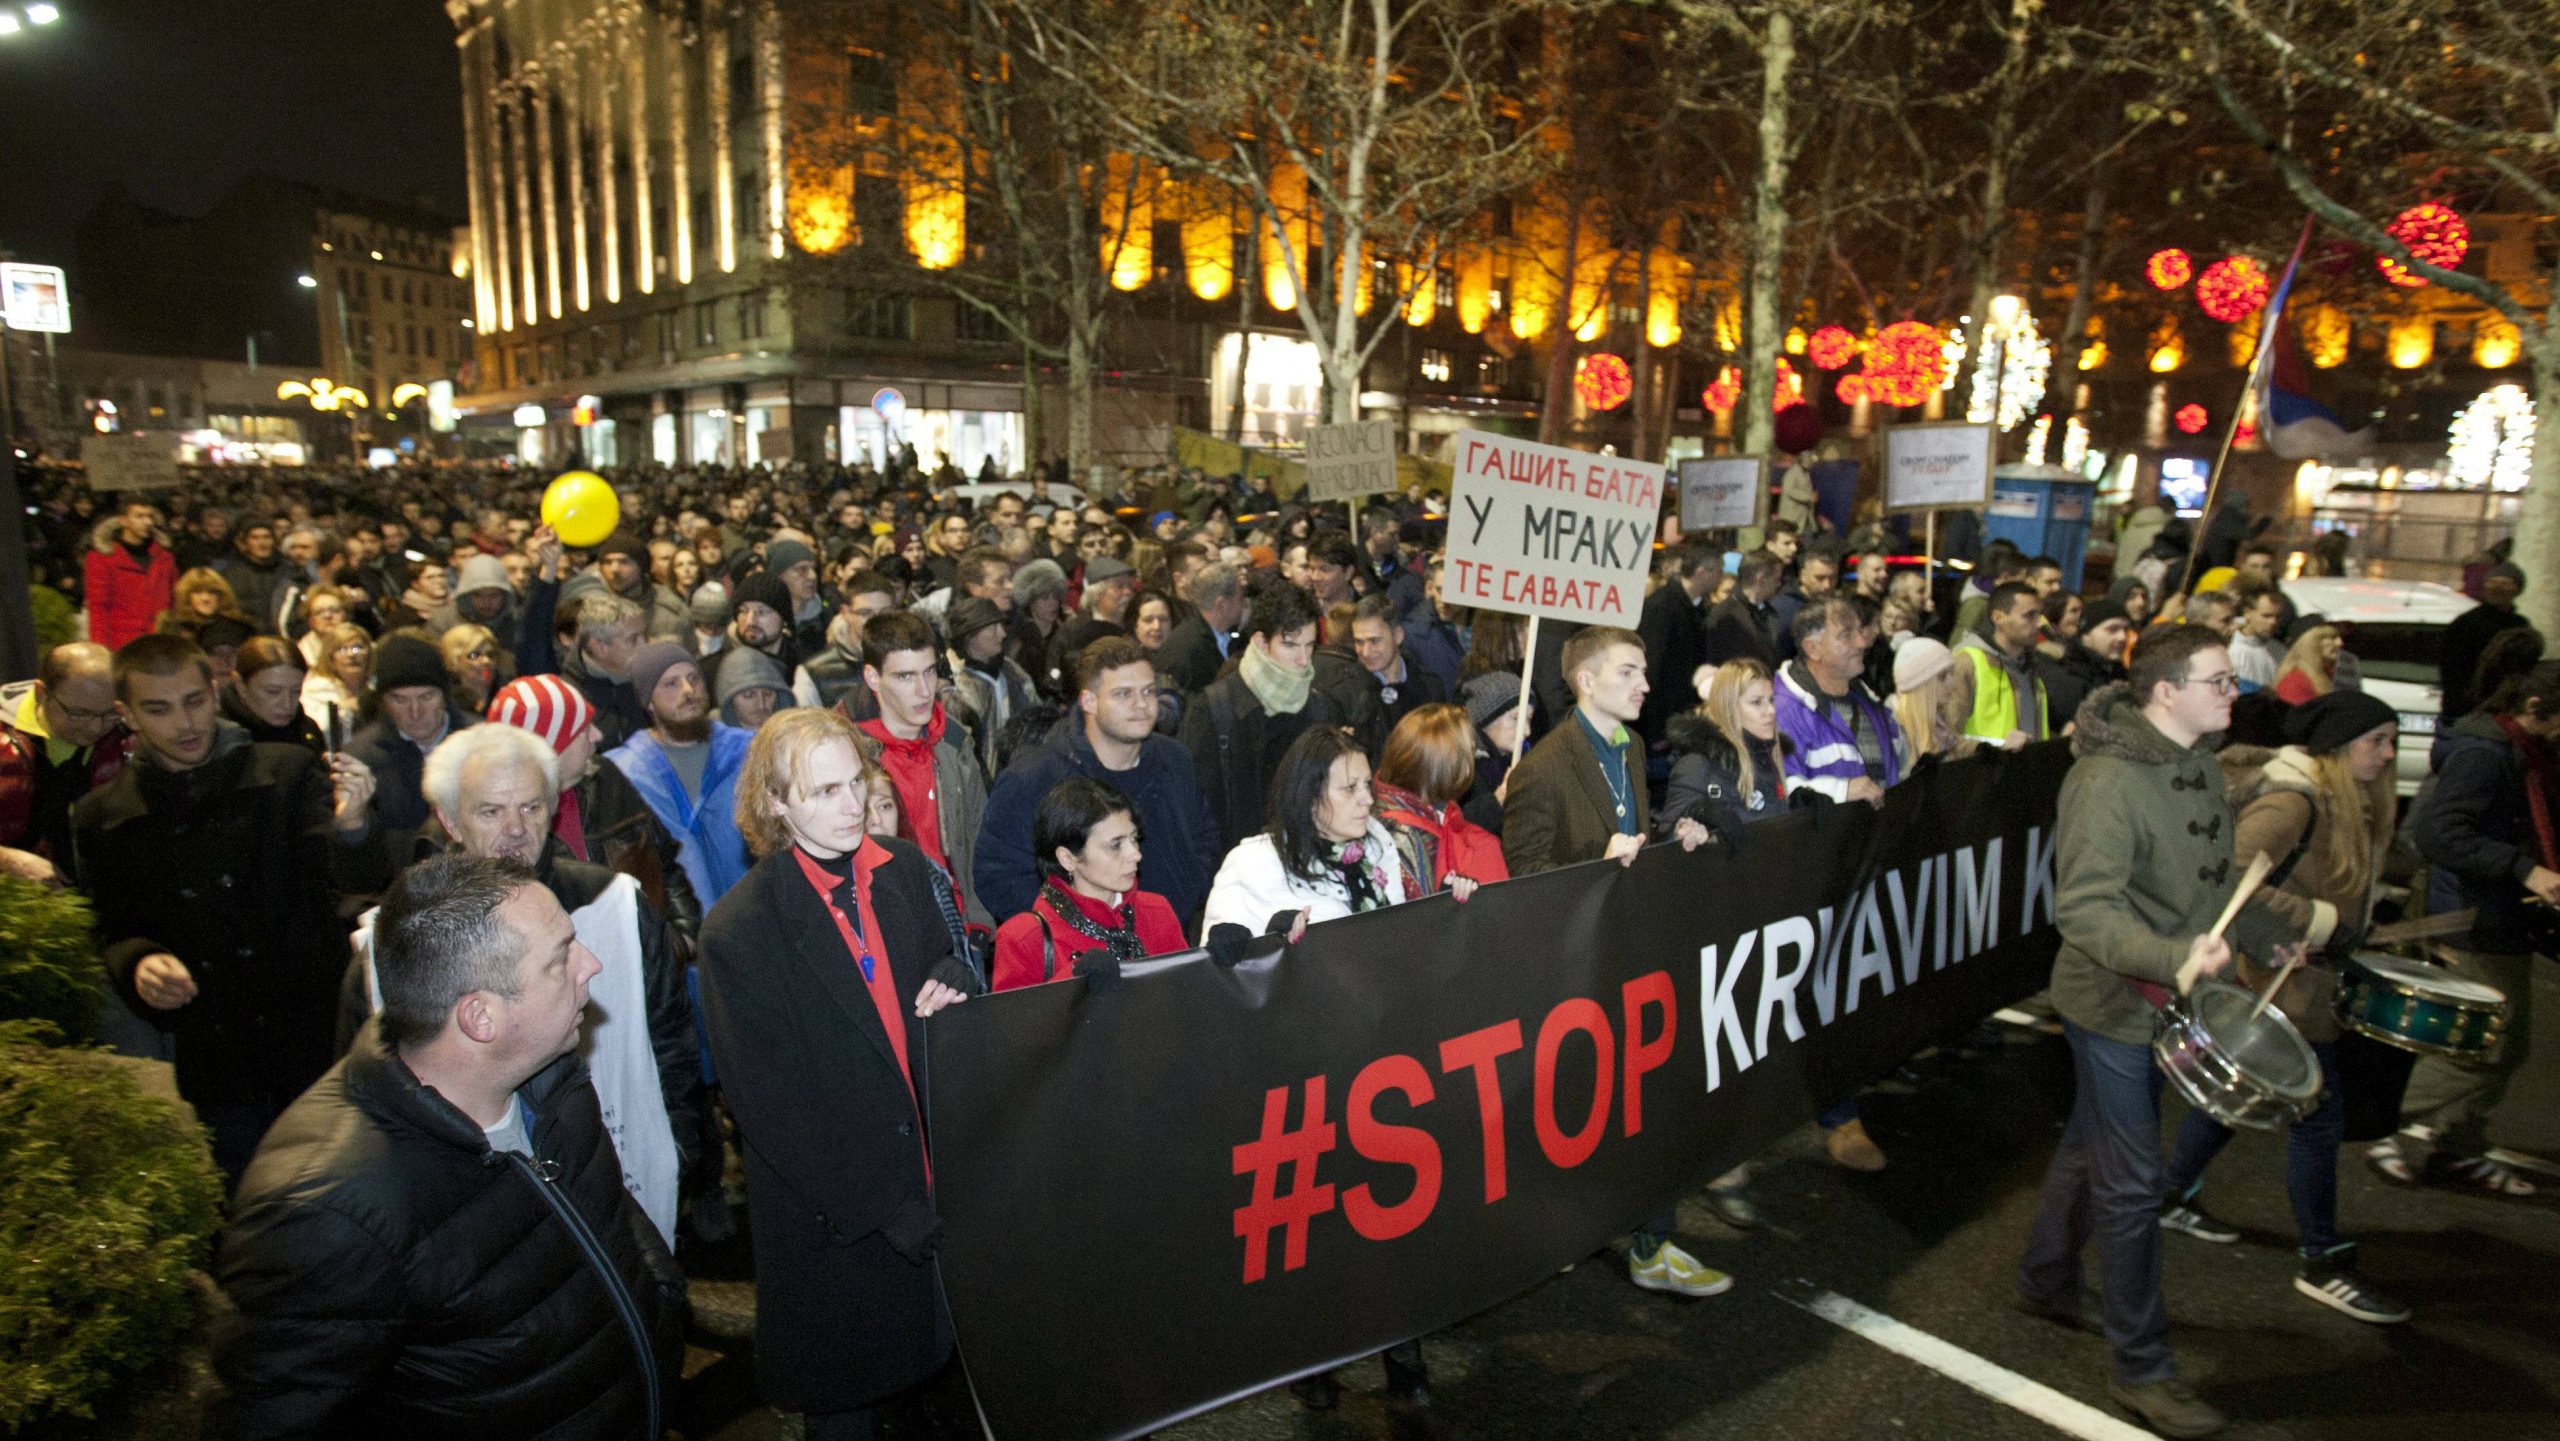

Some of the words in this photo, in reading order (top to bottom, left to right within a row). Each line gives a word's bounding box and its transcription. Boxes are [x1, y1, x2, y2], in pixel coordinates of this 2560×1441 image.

[1467, 441, 1576, 492] ГАШИЋ
[1585, 464, 1657, 509] БАТА
[1464, 494, 1494, 546] У
[1523, 503, 1652, 570] МРАКУ
[1456, 559, 1493, 598] ТЕ
[1502, 569, 1622, 613] САВАТА
[1232, 970, 1677, 1285] #STOP
[1700, 836, 2003, 1093] KRVAVIM
